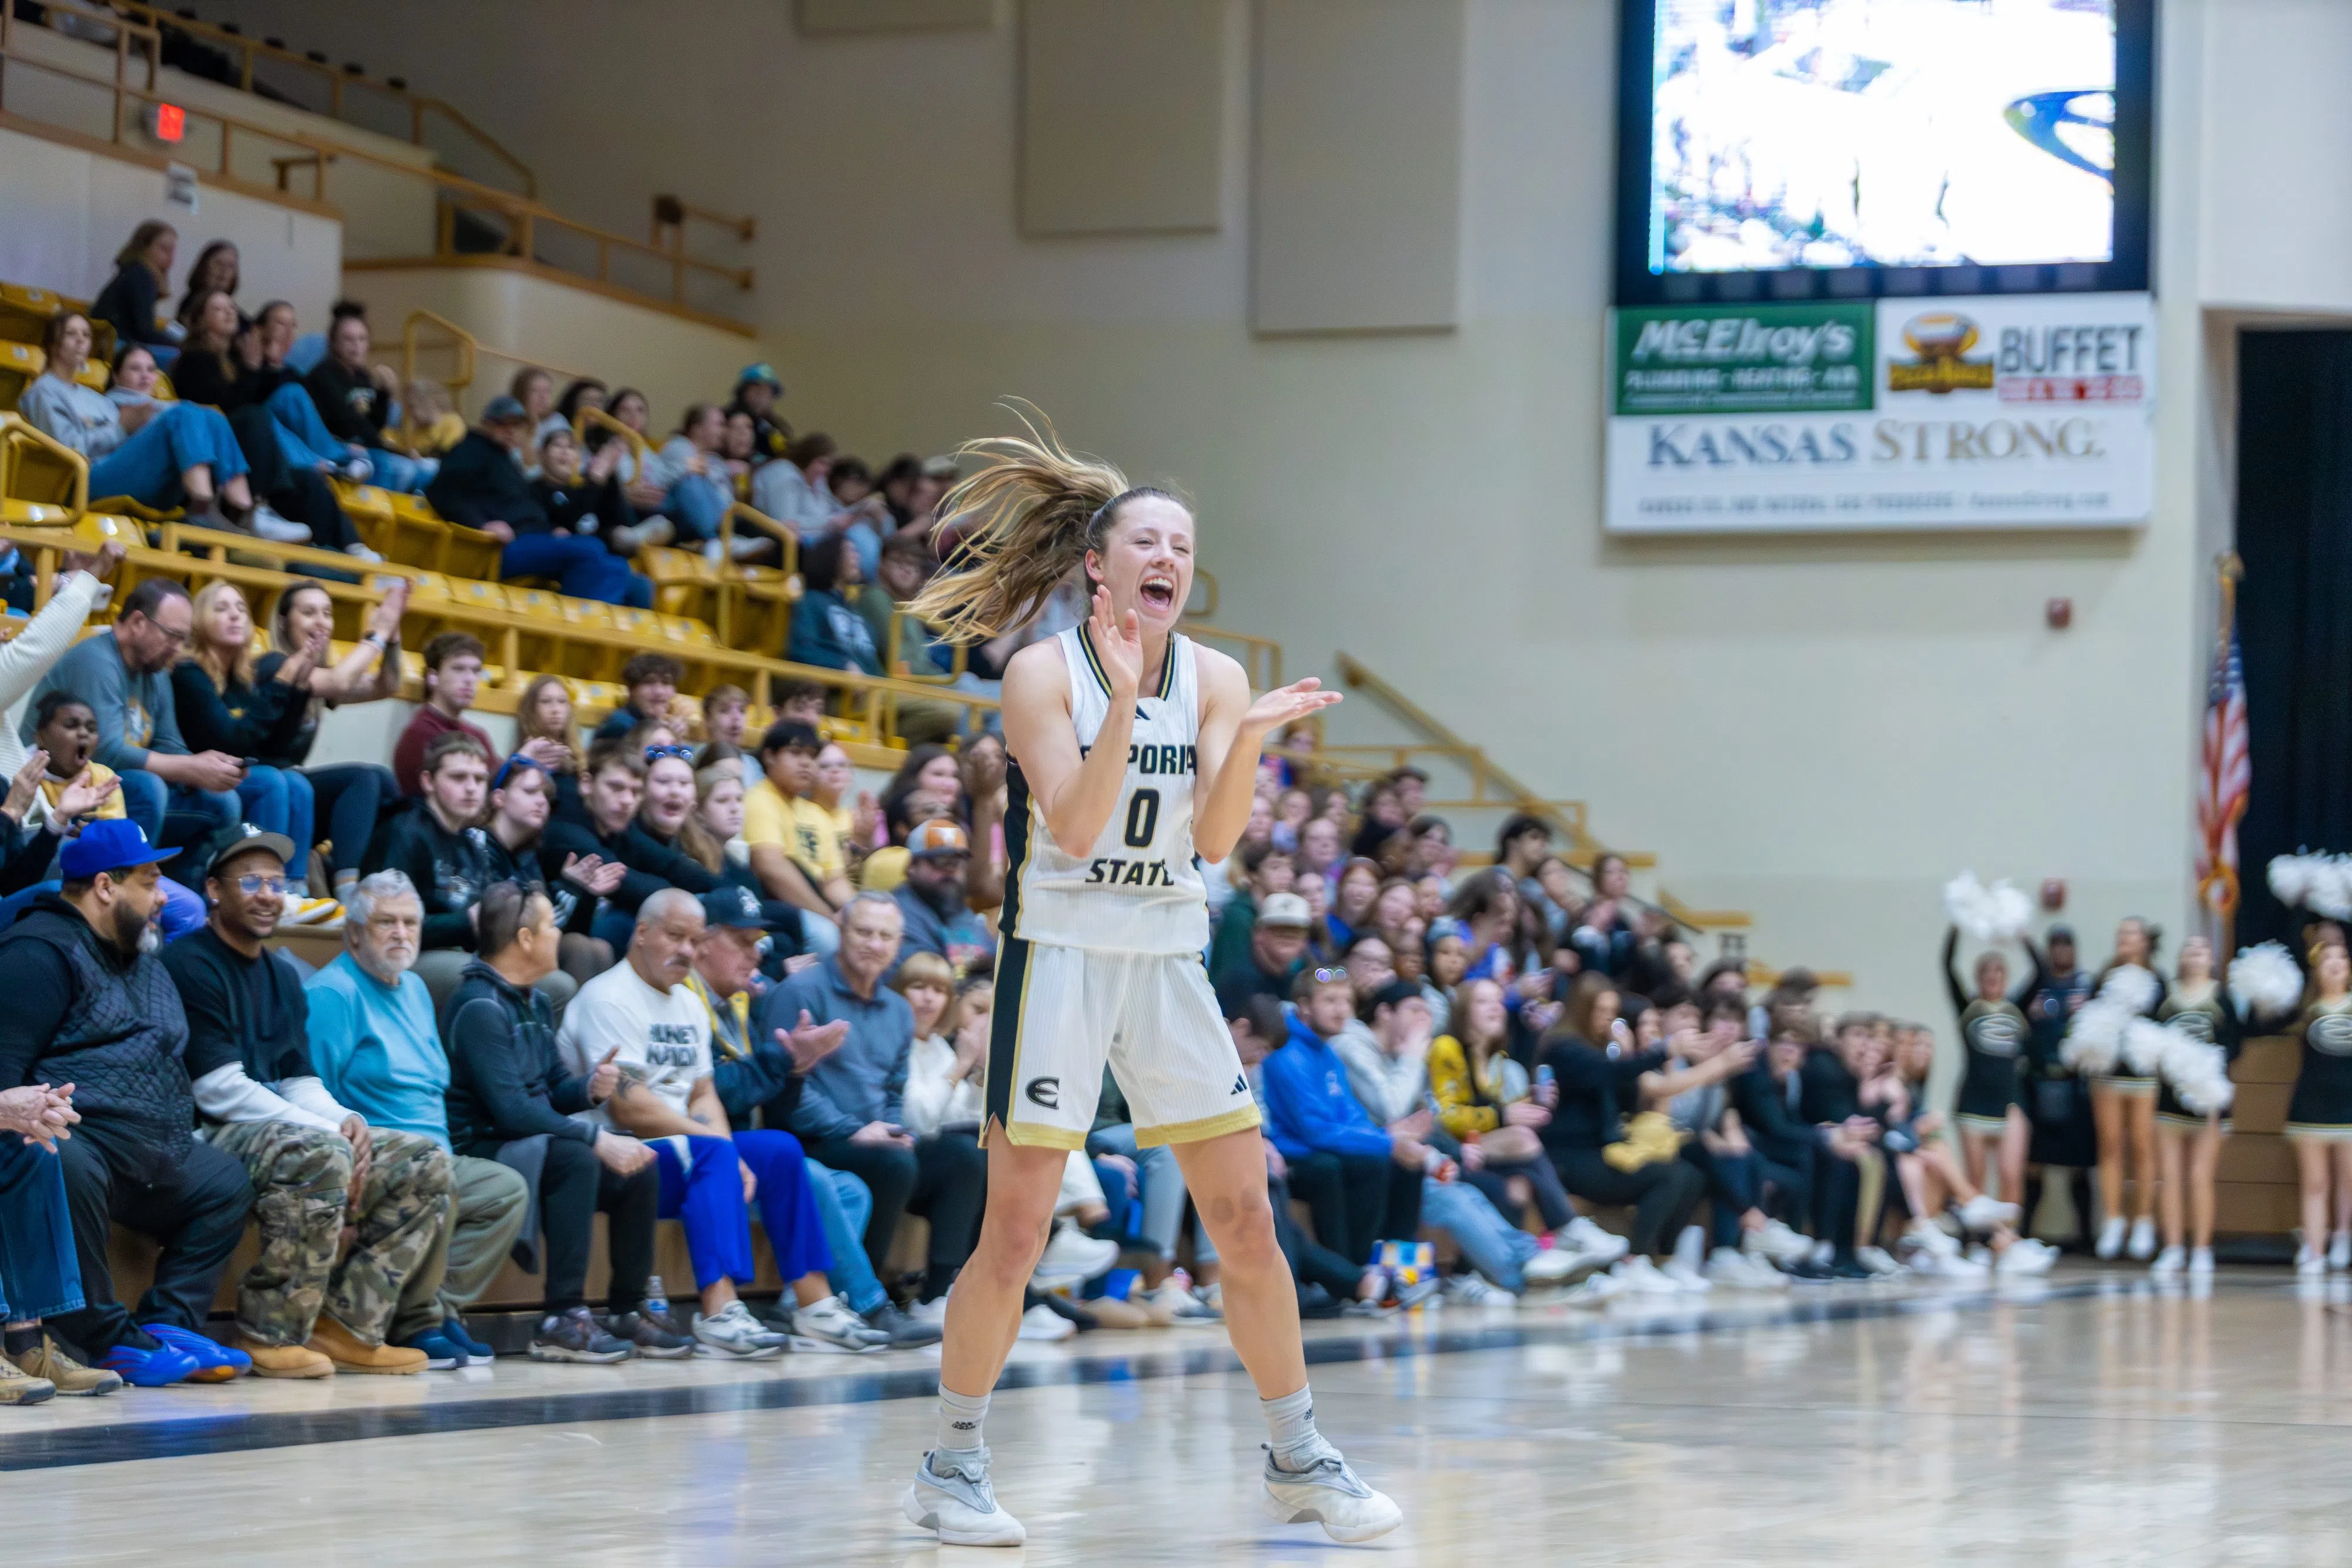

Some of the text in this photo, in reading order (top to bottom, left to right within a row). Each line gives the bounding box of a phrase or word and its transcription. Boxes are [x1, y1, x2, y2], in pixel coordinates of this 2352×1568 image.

[2000, 324, 2143, 372] BUFFET
[1647, 422, 1856, 467] KANSAS
[1124, 787, 1161, 848] 0
